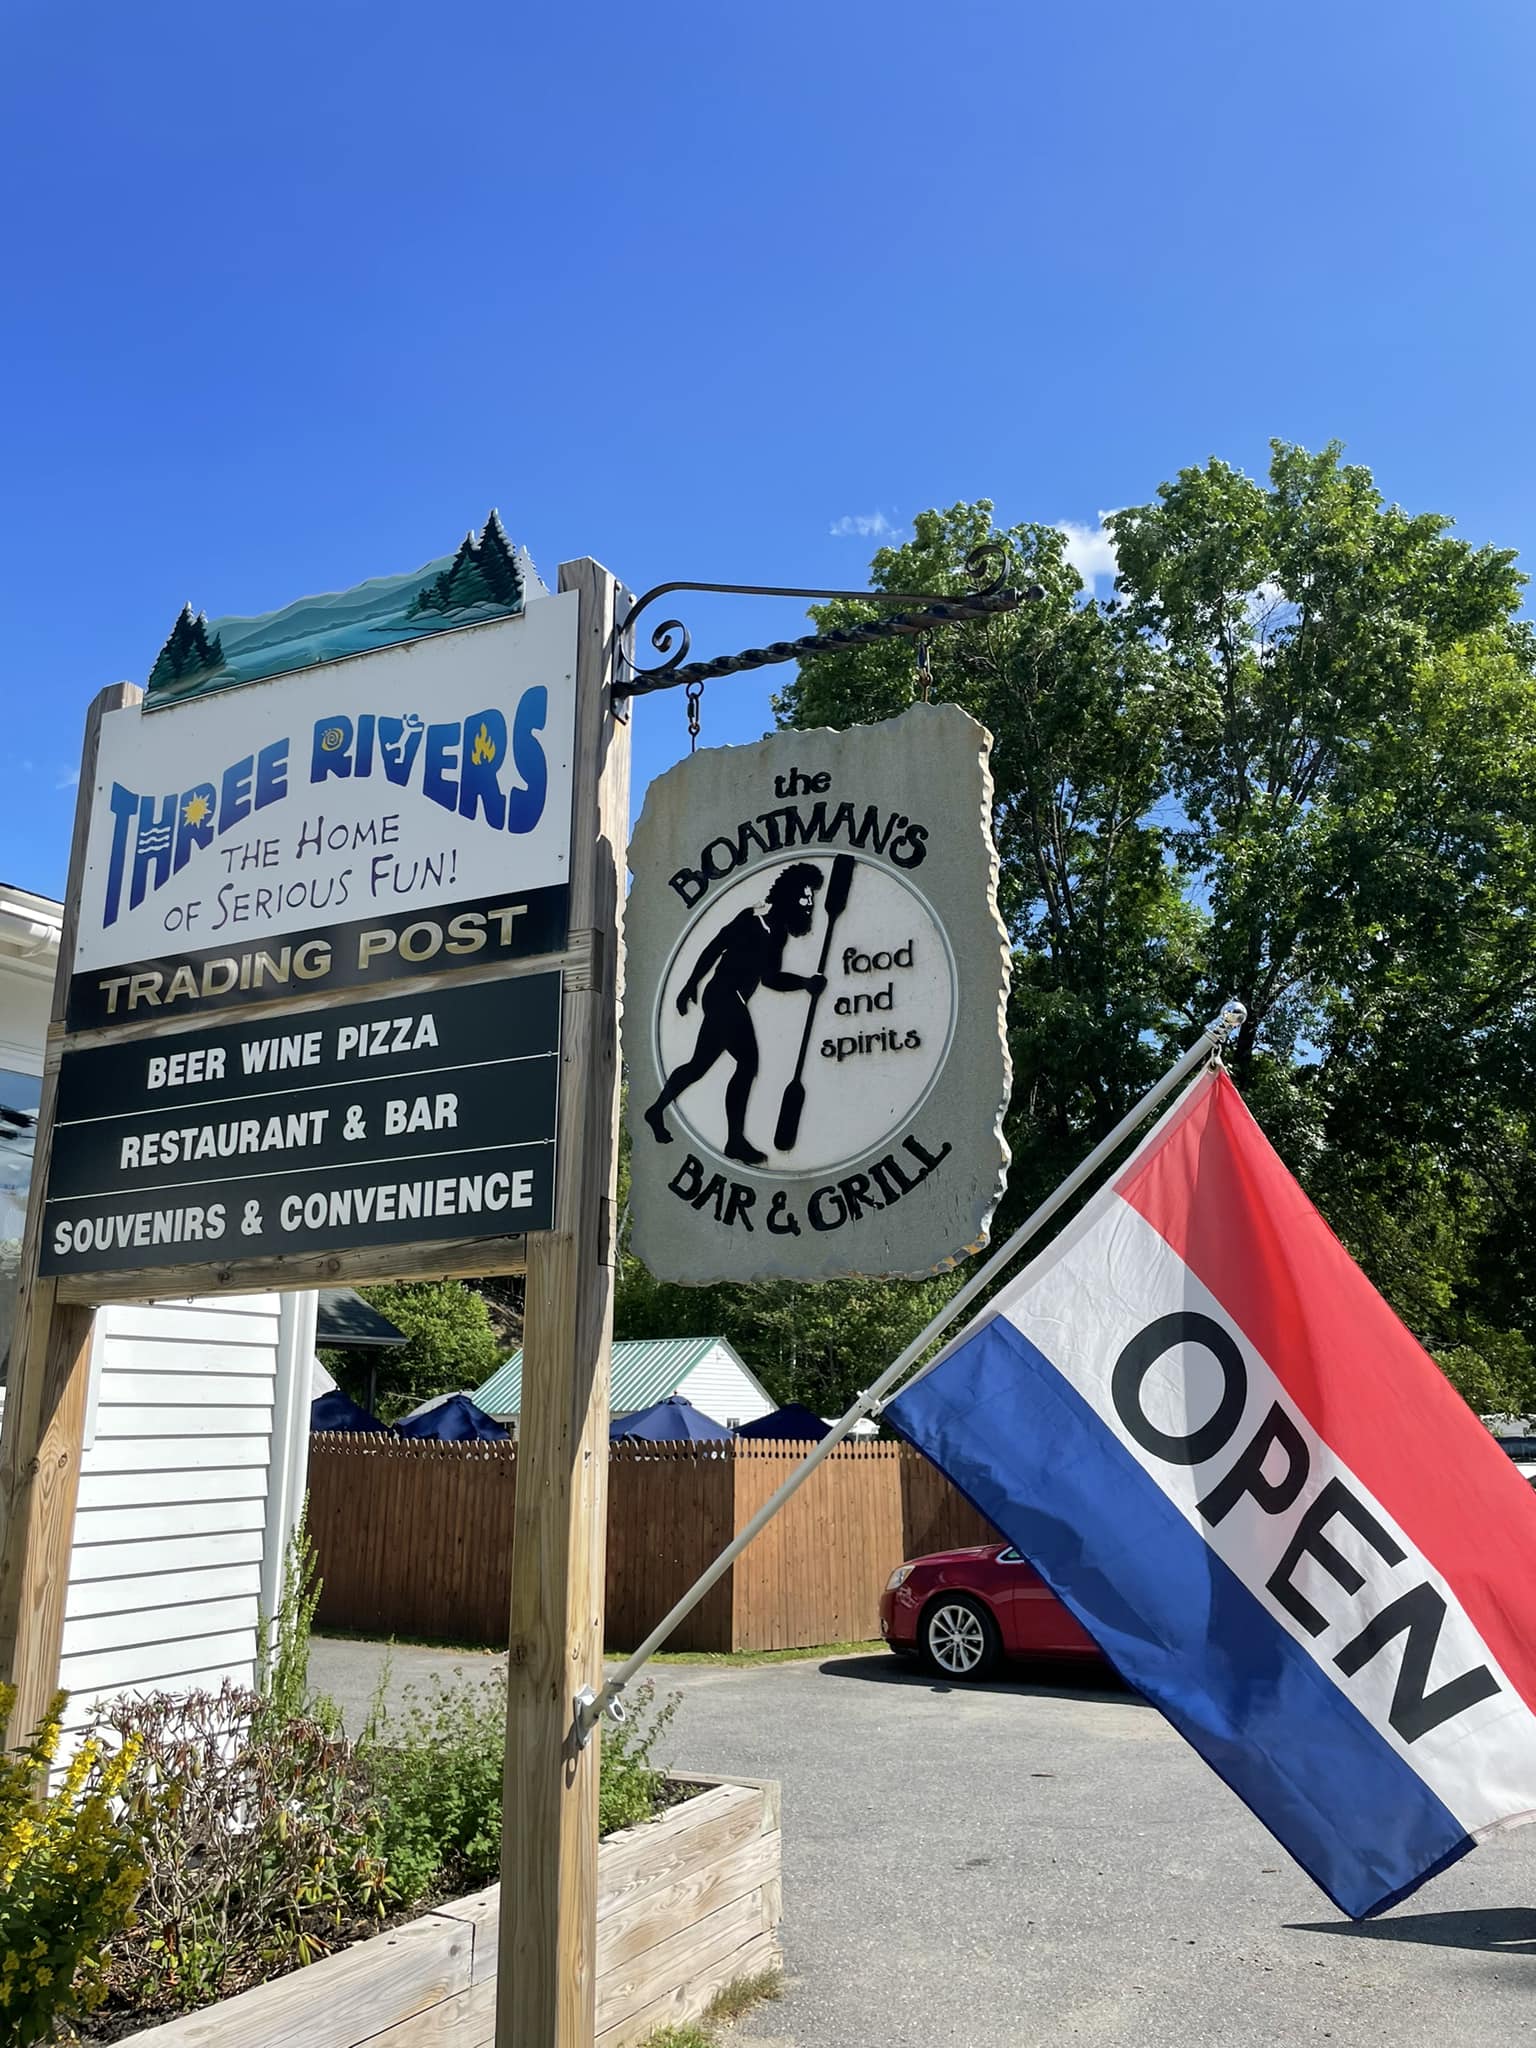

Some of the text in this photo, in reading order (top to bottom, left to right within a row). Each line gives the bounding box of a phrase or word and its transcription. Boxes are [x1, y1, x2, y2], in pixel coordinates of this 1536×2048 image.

[104, 685, 548, 929] THREE RIVERS
[774, 767, 831, 798] the
[221, 814, 400, 873] THE HOME
[668, 801, 928, 909] BOATMAN'S
[164, 848, 457, 932] OF SERIOUS FUN!
[100, 904, 528, 1014] TRADING POST
[842, 940, 914, 974] food
[833, 983, 893, 1016] and
[147, 1014, 439, 1090] BEER WINE PIZZA
[820, 1028, 921, 1062] spirits
[120, 1093, 458, 1169] RESTAURANT & BAR
[54, 1169, 534, 1256] SOUVENIRS & CONVENIENCE
[668, 1134, 952, 1236] BAR & GRILL
[1111, 1311, 1502, 1744] OPEN
